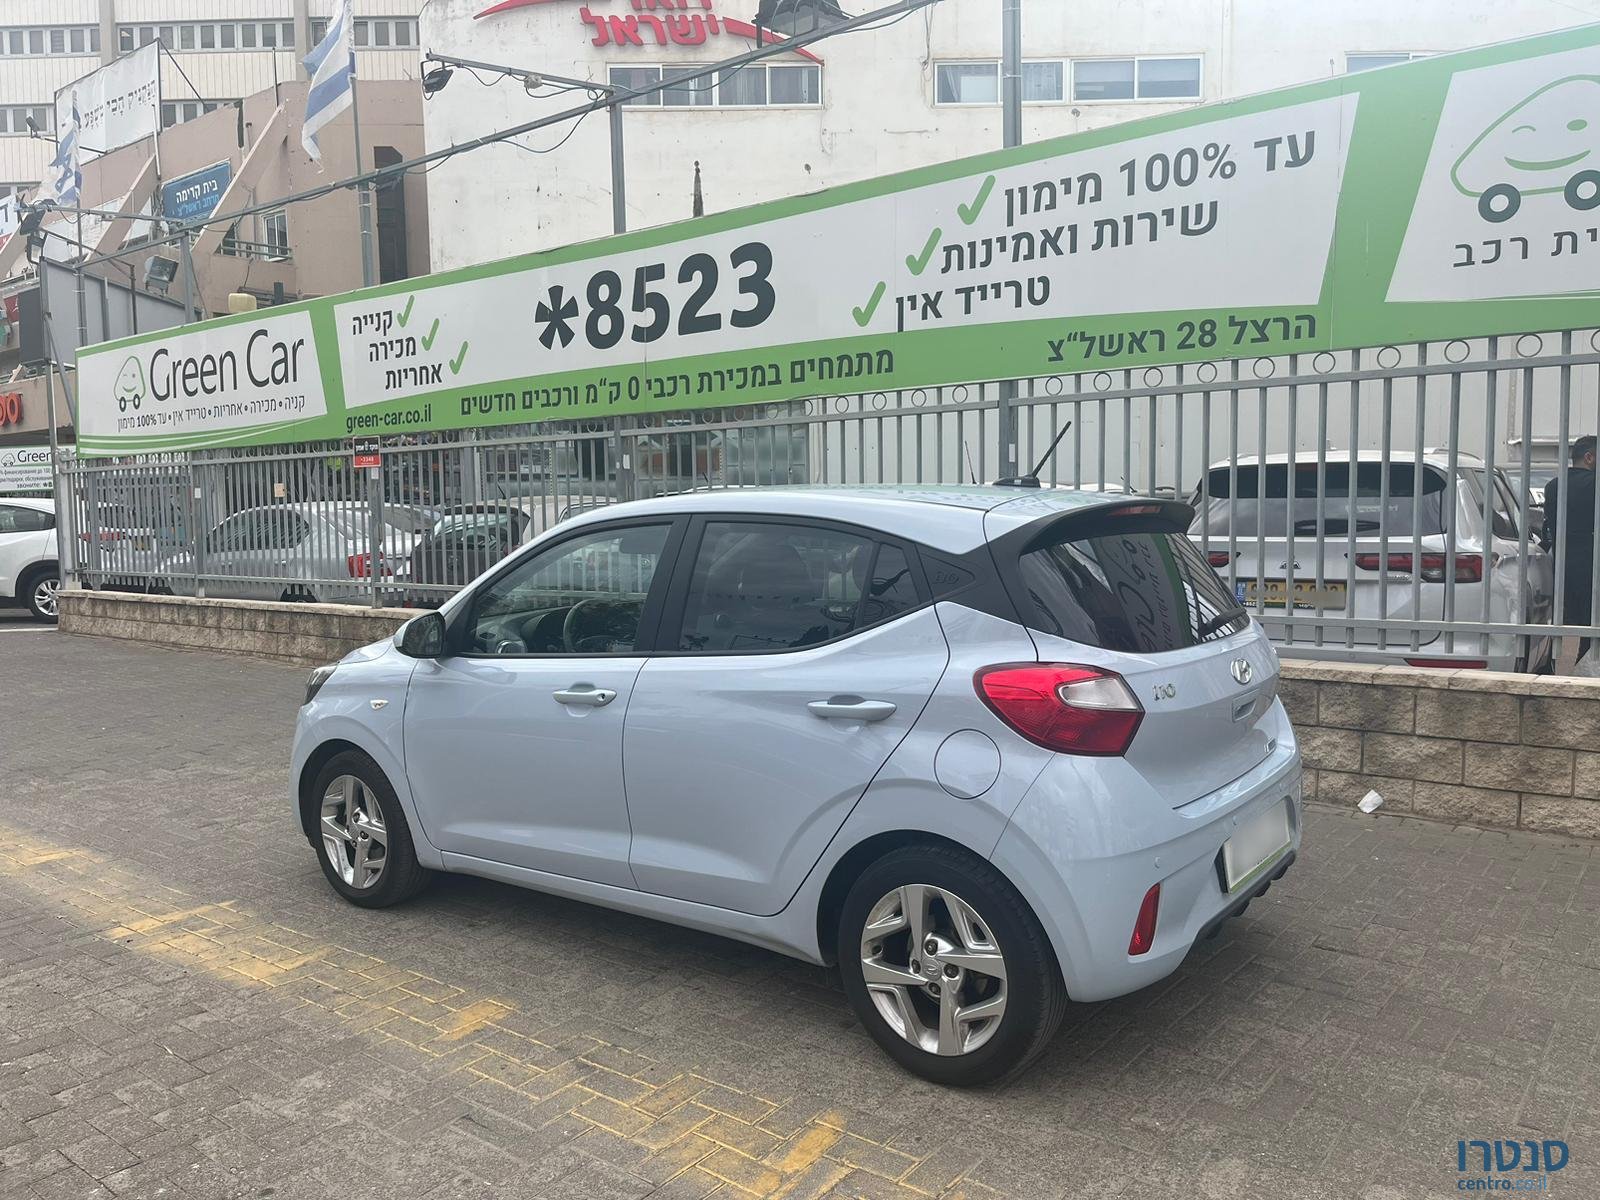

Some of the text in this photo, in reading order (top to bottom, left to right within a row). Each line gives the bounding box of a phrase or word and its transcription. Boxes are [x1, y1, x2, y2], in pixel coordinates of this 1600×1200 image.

[579, 7, 719, 47] ישראל
[175, 180, 218, 204] בית קדימה
[1004, 130, 1316, 227] עד 100% מימון
[941, 200, 1219, 275] שירות ואמינות
[1453, 236, 1528, 268] רכב
[895, 275, 1051, 333] טרייד אין
[352, 310, 393, 337] קנייה
[1177, 319, 1217, 350] 28
[1228, 313, 1316, 346] הרצל
[369, 336, 417, 362] מכירה
[150, 328, 305, 402] Green Car
[385, 363, 443, 390] אחריות
[697, 363, 783, 396] במכירת
[789, 348, 895, 385] מתמחים
[521, 384, 579, 411] ורכבים
[627, 376, 640, 402] 0
[645, 374, 691, 400] רכבי
[117, 395, 306, 433] קניה מכירה אחריות טרייד אין עד 100% מימון
[346, 403, 432, 434] green-car.co.il
[460, 391, 517, 416] חדשים
